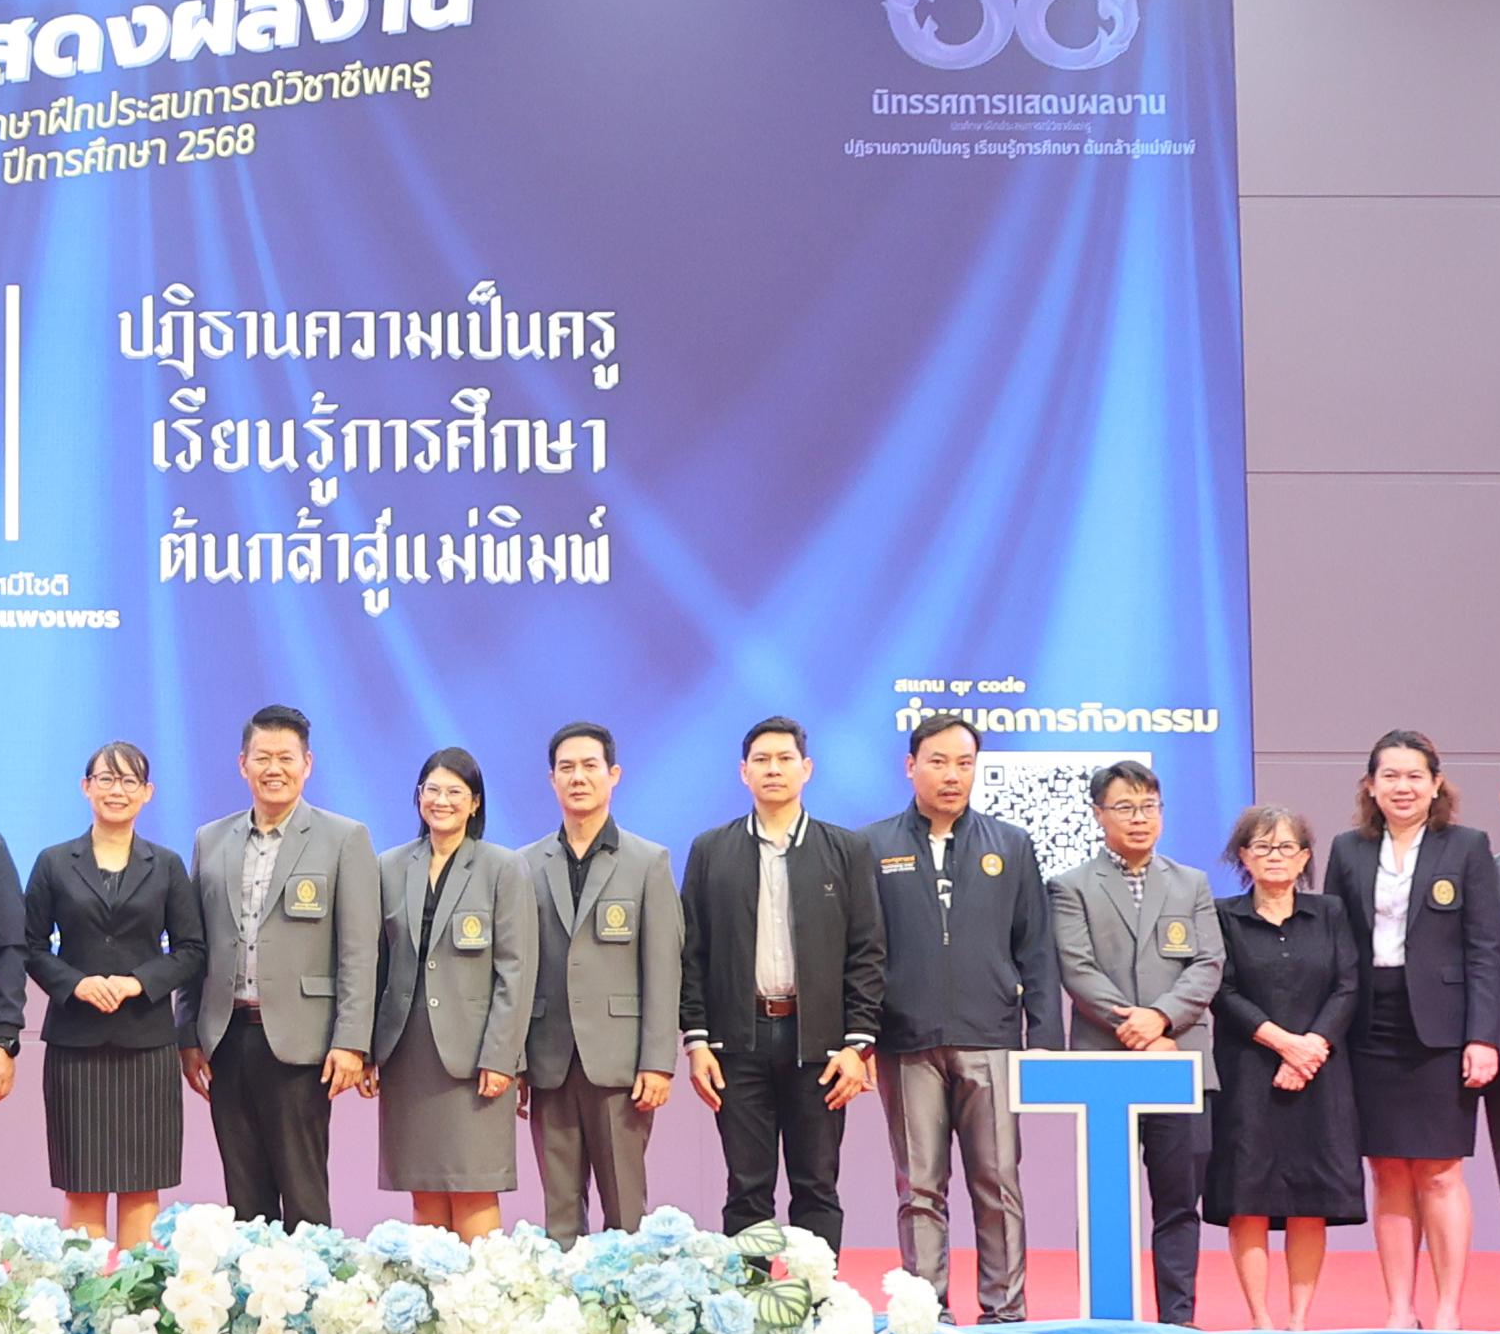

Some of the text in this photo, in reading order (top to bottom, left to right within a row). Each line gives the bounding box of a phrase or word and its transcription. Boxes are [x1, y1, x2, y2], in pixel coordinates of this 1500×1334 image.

[871, 89, 1167, 116] นิทรรศการแสดงผลงาน
[2, 123, 257, 185] ปีการศึกษา 2568
[151, 385, 608, 508] เรียนรู้การศึกษา
[158, 504, 612, 618] ต้นกล้าสู่แม่พิมพ์
[894, 676, 1026, 697] สแกน qr code
